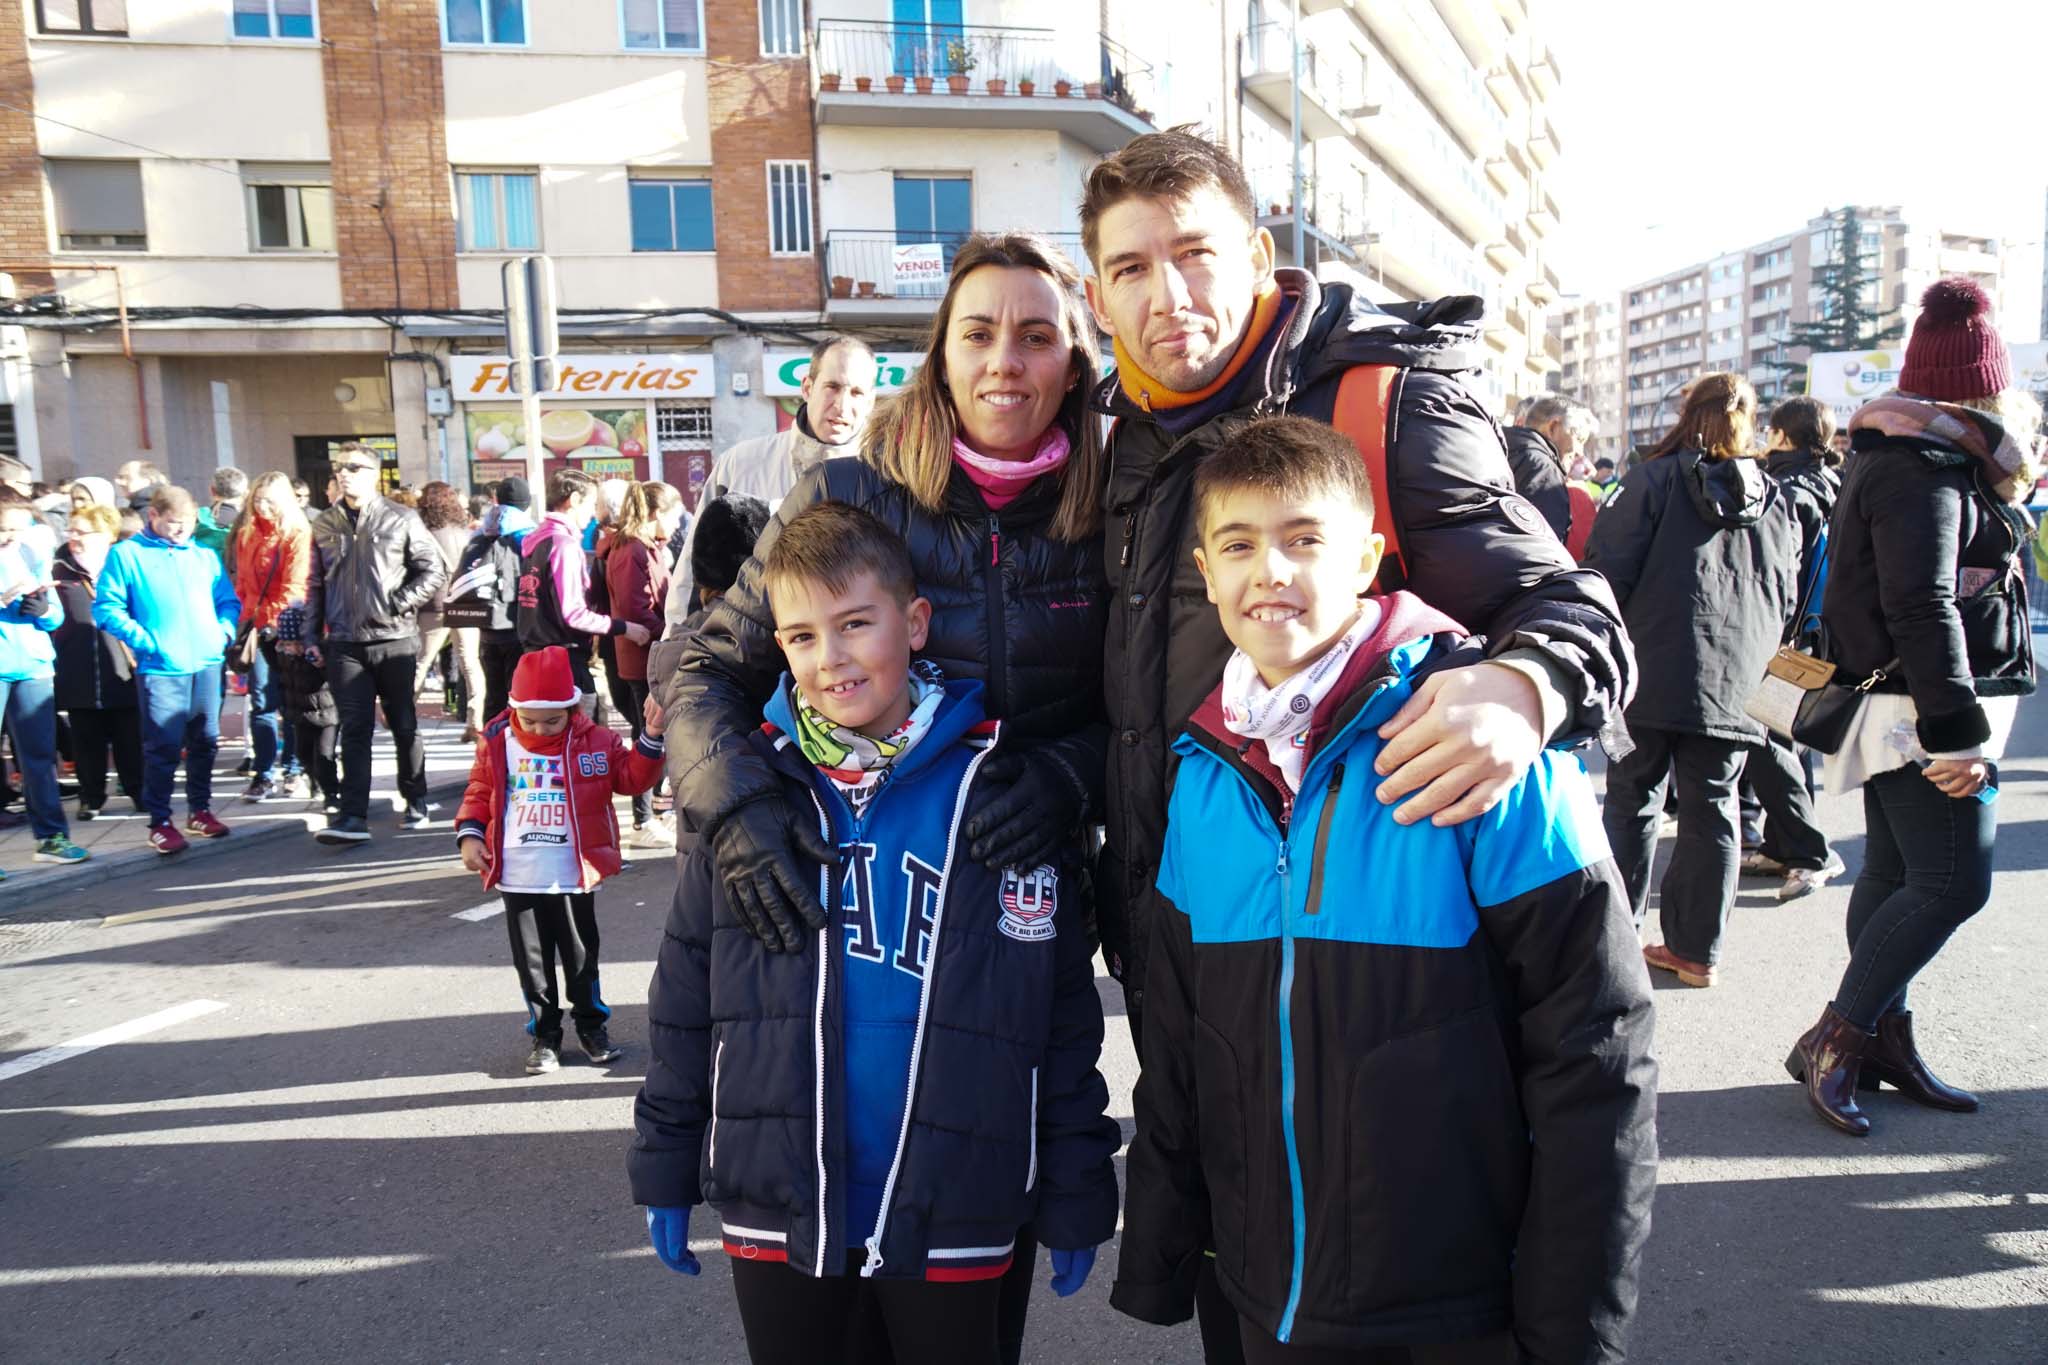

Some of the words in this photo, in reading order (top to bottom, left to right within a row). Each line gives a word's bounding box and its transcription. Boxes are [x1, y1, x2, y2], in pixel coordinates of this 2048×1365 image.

[895, 260, 941, 271] VENDE
[578, 752, 609, 777] 65
[517, 804, 565, 827] 7409
[1004, 921, 1018, 933] THE
[1019, 928, 1031, 936] BIG
[1032, 926, 1051, 936] GAME
